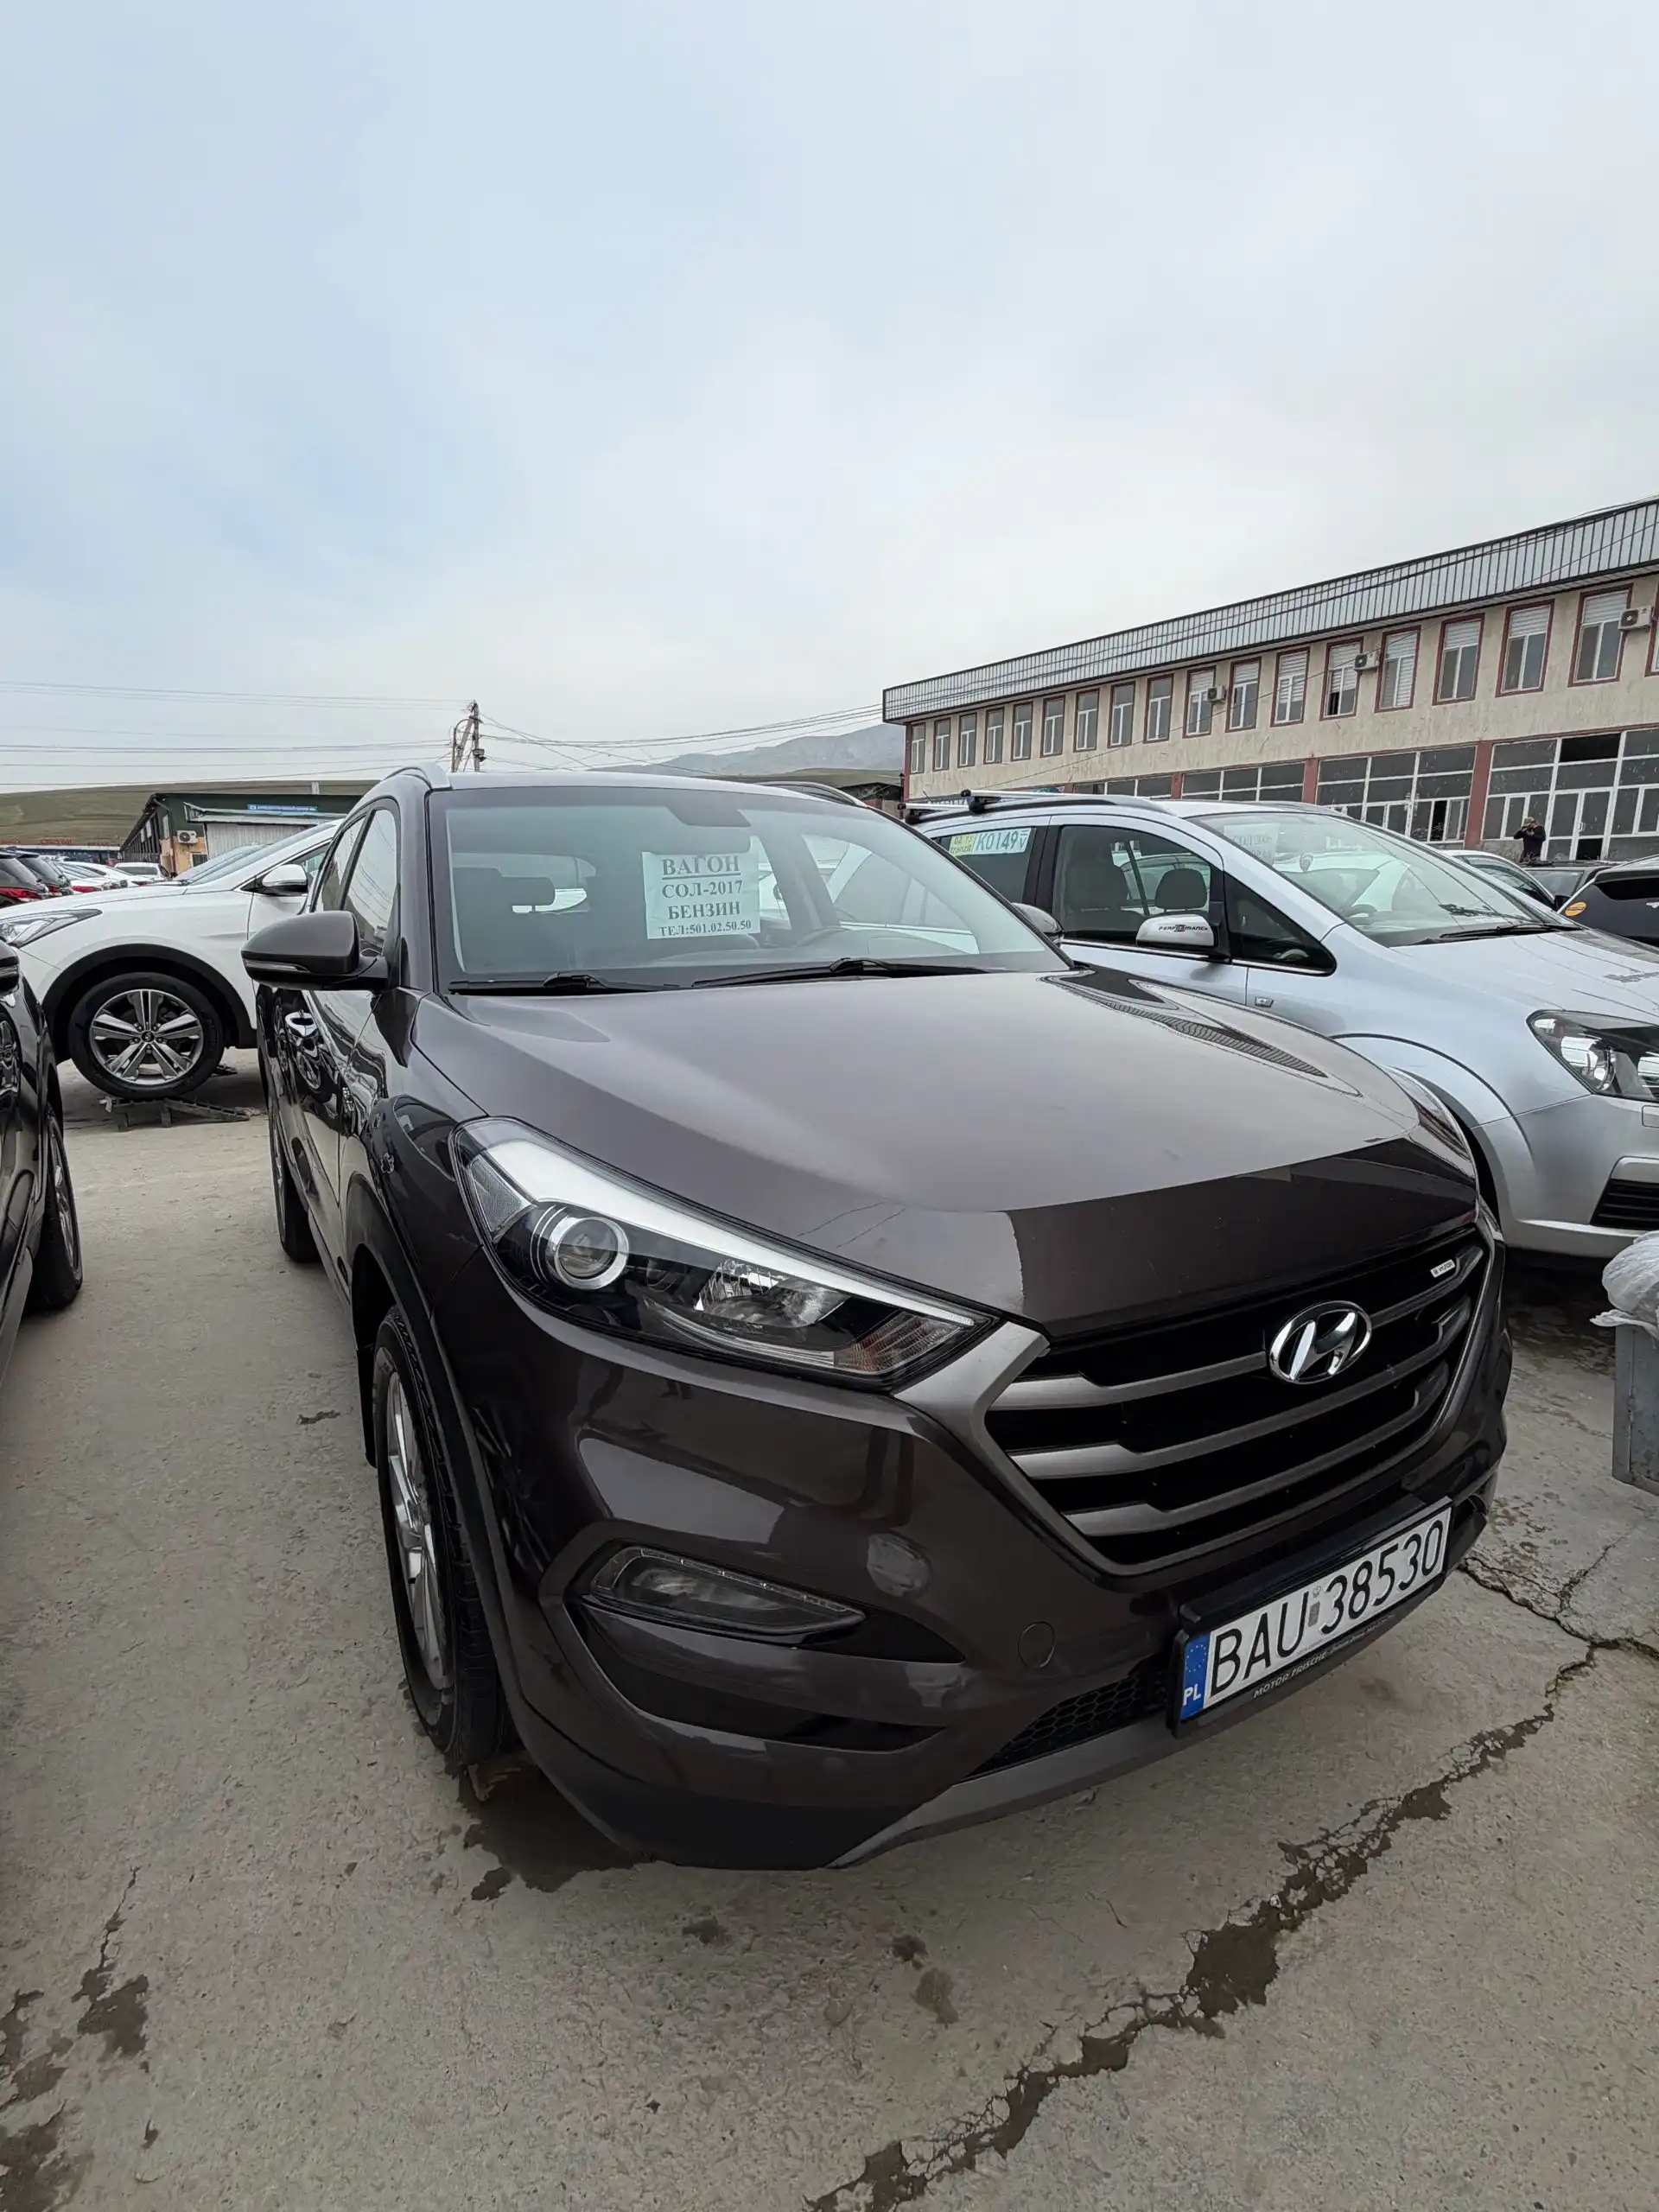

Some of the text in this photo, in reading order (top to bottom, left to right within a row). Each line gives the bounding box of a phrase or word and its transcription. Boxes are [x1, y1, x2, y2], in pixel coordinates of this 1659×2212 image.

[662, 855, 741, 876] ВАГОН
[662, 880, 743, 899] СОЛ-2017
[668, 901, 741, 919] БЕНЗИН
[658, 920, 752, 937] ТЕЛ:501.02.50.50
[1210, 1520, 1444, 1698] BAU 38530
[1182, 1683, 1202, 1706] PL
